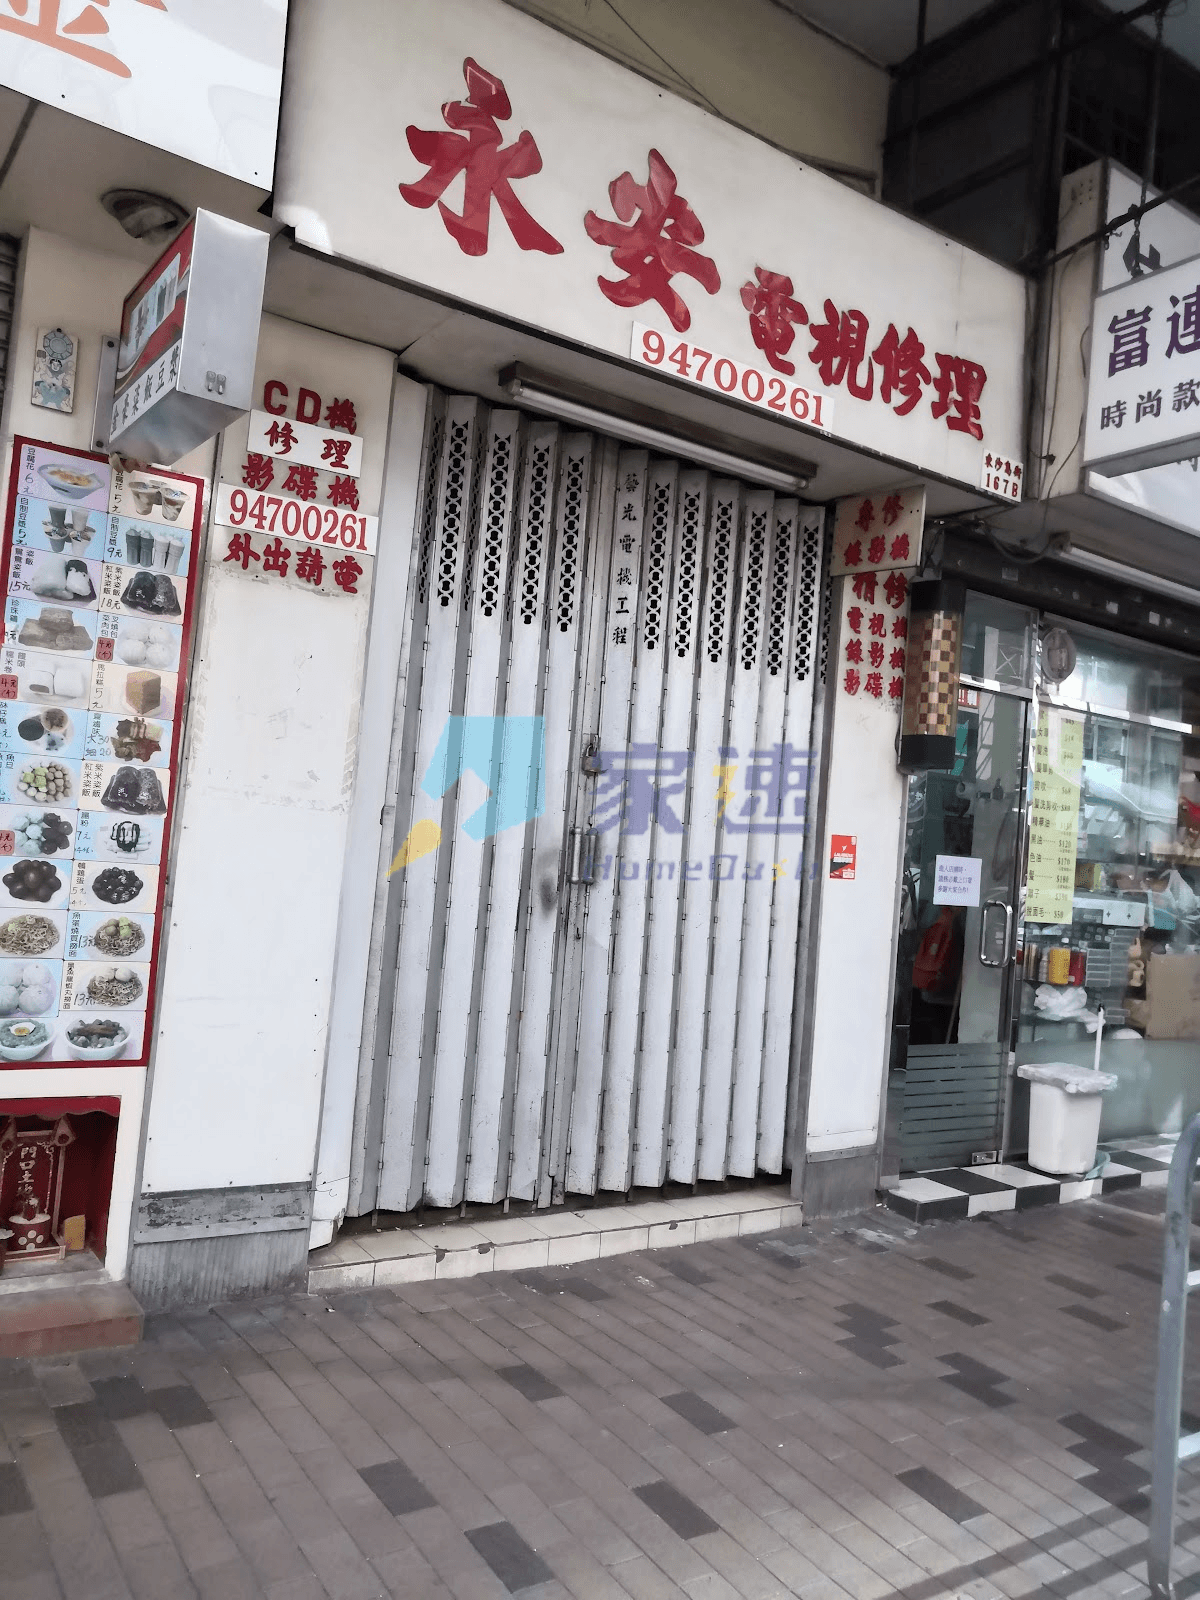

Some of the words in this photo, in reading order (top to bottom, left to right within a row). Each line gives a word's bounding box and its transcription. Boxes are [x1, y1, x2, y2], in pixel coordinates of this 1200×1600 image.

[642, 329, 825, 427] 94700261
[740, 266, 988, 440] 電視修理
[264, 380, 357, 435] CD機
[264, 420, 352, 470] 修理
[241, 454, 360, 511] 影碟機
[986, 473, 1019, 497] 167B
[229, 489, 368, 551] 94700261
[107, 547, 123, 558] 9元
[223, 533, 363, 594] 外出請電
[9, 580, 32, 592] 15元
[100, 597, 121, 610] 18元
